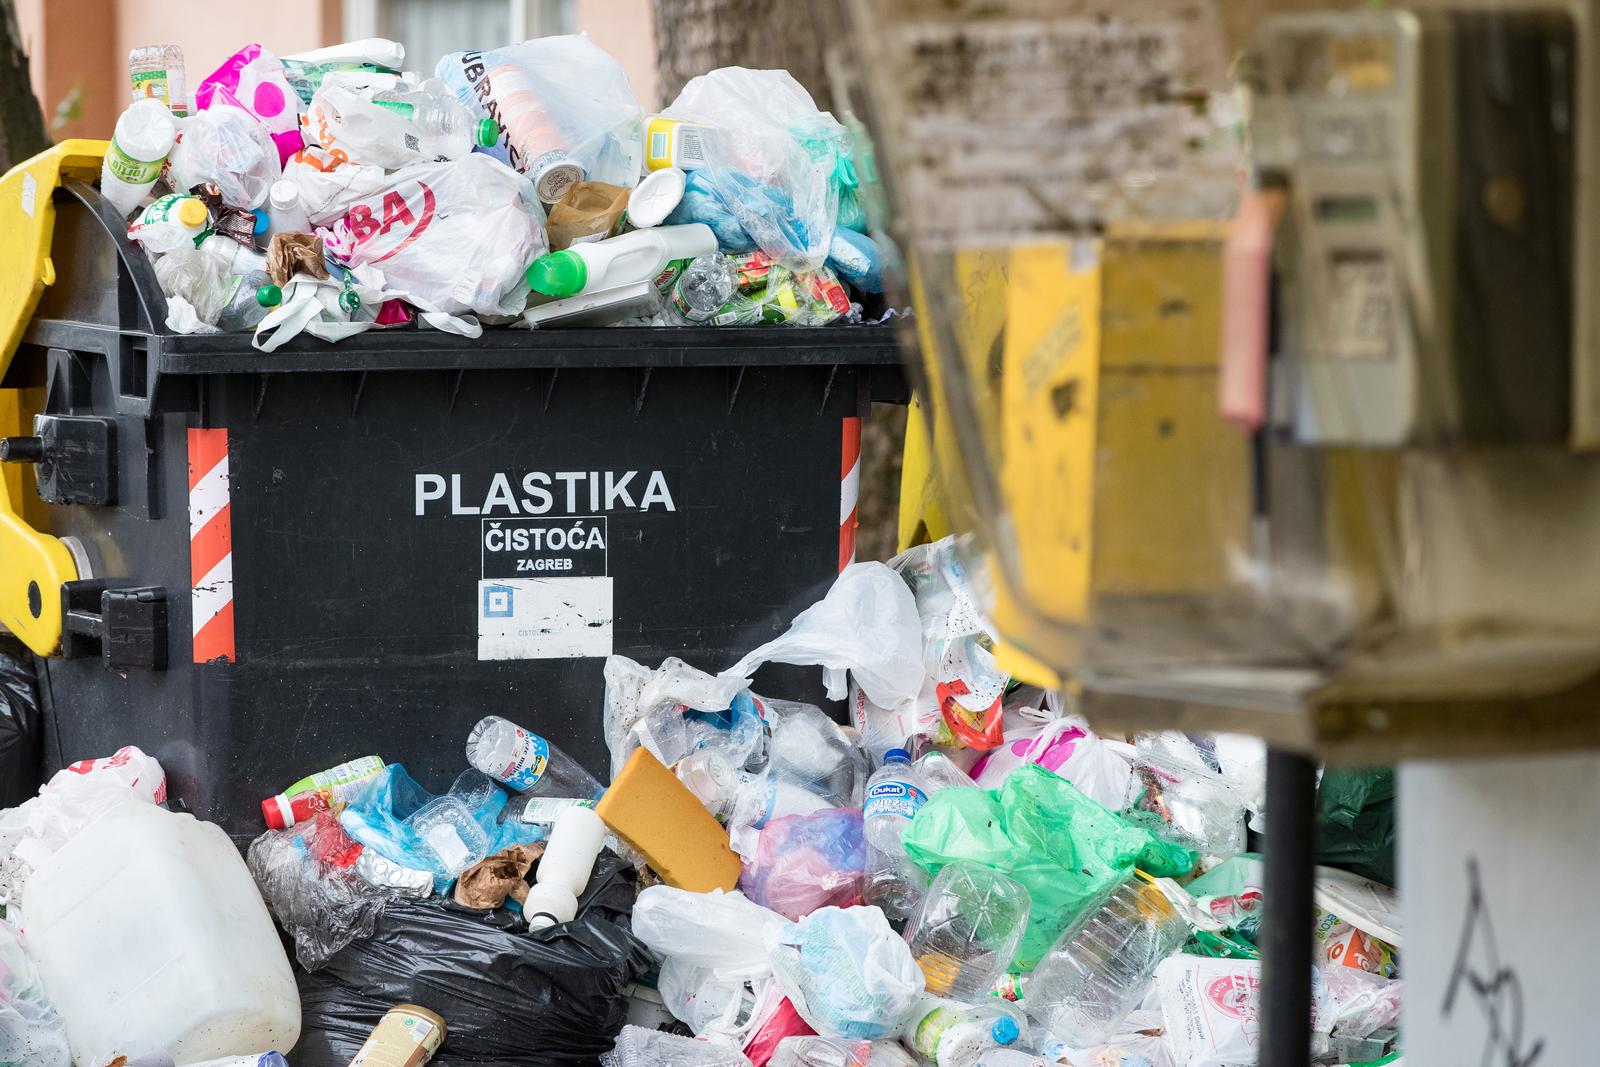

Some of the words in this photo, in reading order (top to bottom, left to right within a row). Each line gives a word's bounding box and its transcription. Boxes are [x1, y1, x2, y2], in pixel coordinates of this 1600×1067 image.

[415, 470, 676, 516] PLASTIKA
[485, 521, 606, 552] ČISTOĆA
[516, 558, 573, 572] ZAGREB
[873, 786, 901, 795] Dukat
